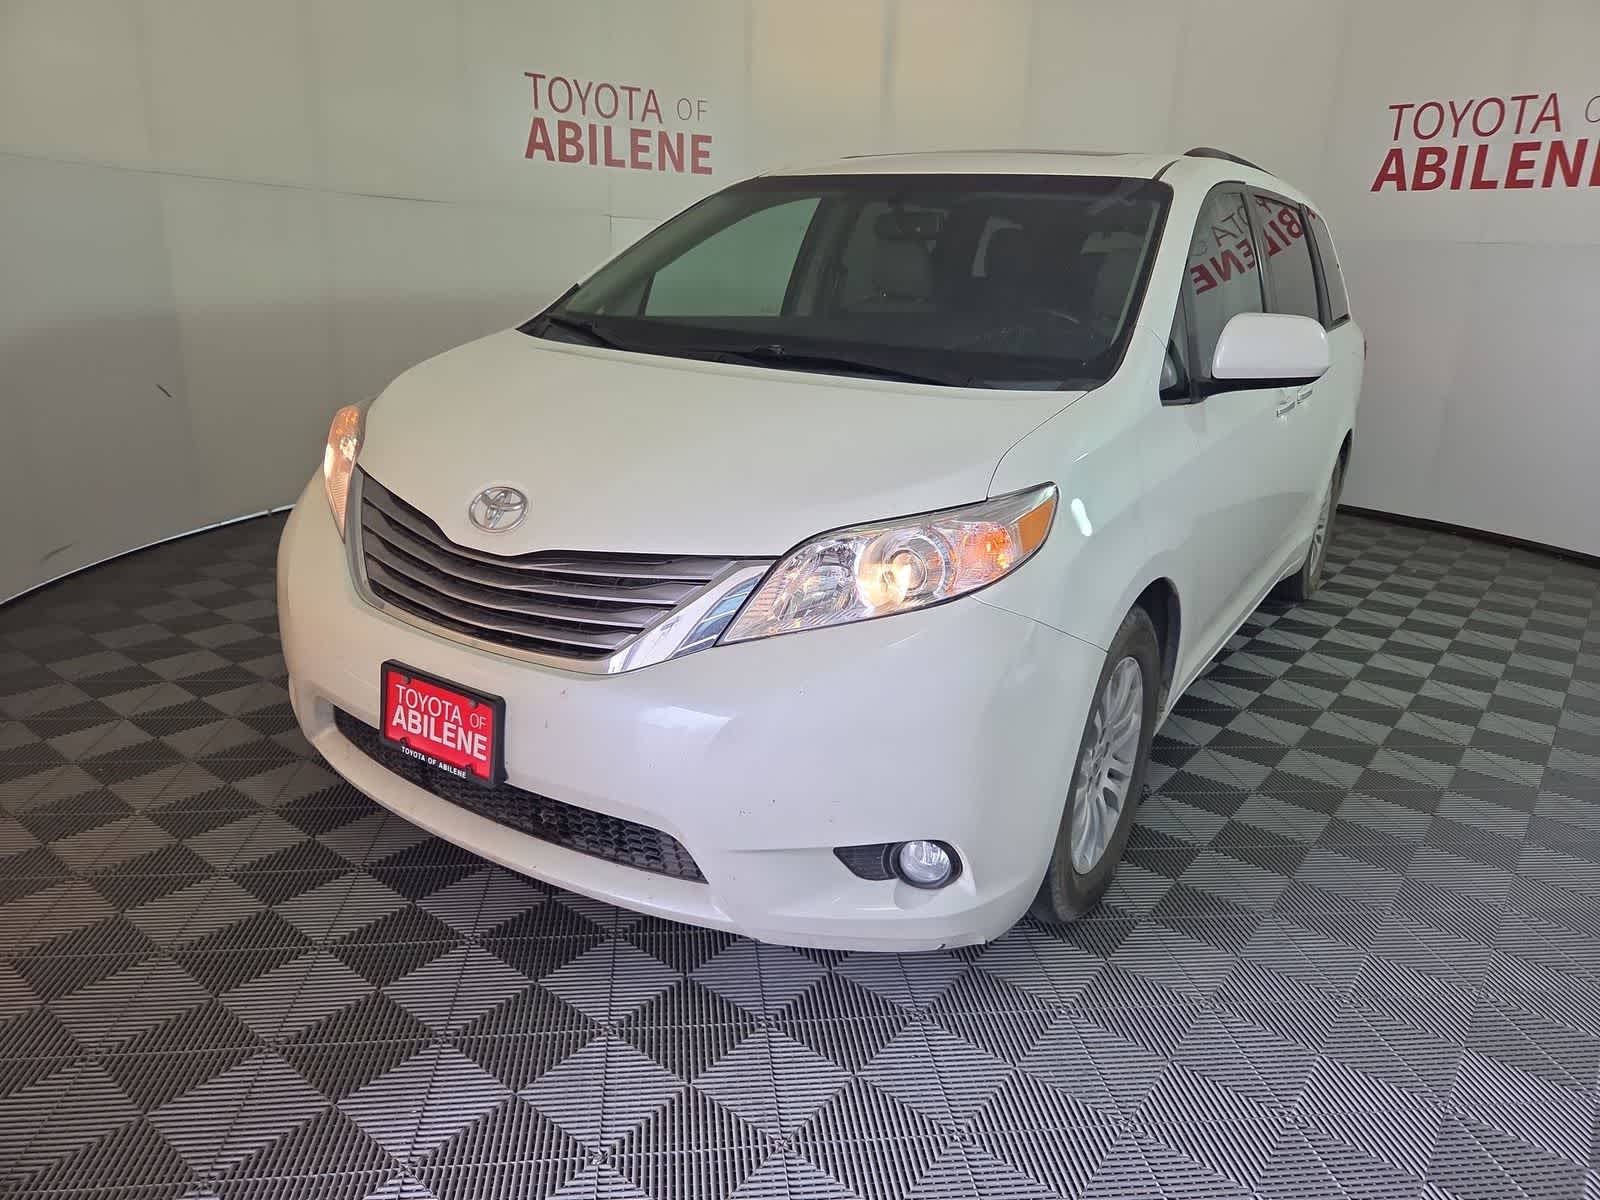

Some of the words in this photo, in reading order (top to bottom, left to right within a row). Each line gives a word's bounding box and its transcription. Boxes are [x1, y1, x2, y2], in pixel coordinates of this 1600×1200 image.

[524, 71, 663, 124] TOYOTA
[676, 97, 707, 122] OF
[1388, 92, 1561, 141] TOYOTA
[1584, 95, 1600, 123] O
[525, 116, 713, 175] ABILENE
[395, 684, 463, 726] TOYOTA
[469, 713, 487, 729] OF
[391, 704, 488, 761] ABILENE
[401, 745, 426, 762] TOYOTA
[427, 757, 437, 766] OF
[438, 762, 467, 779] ABILENE
